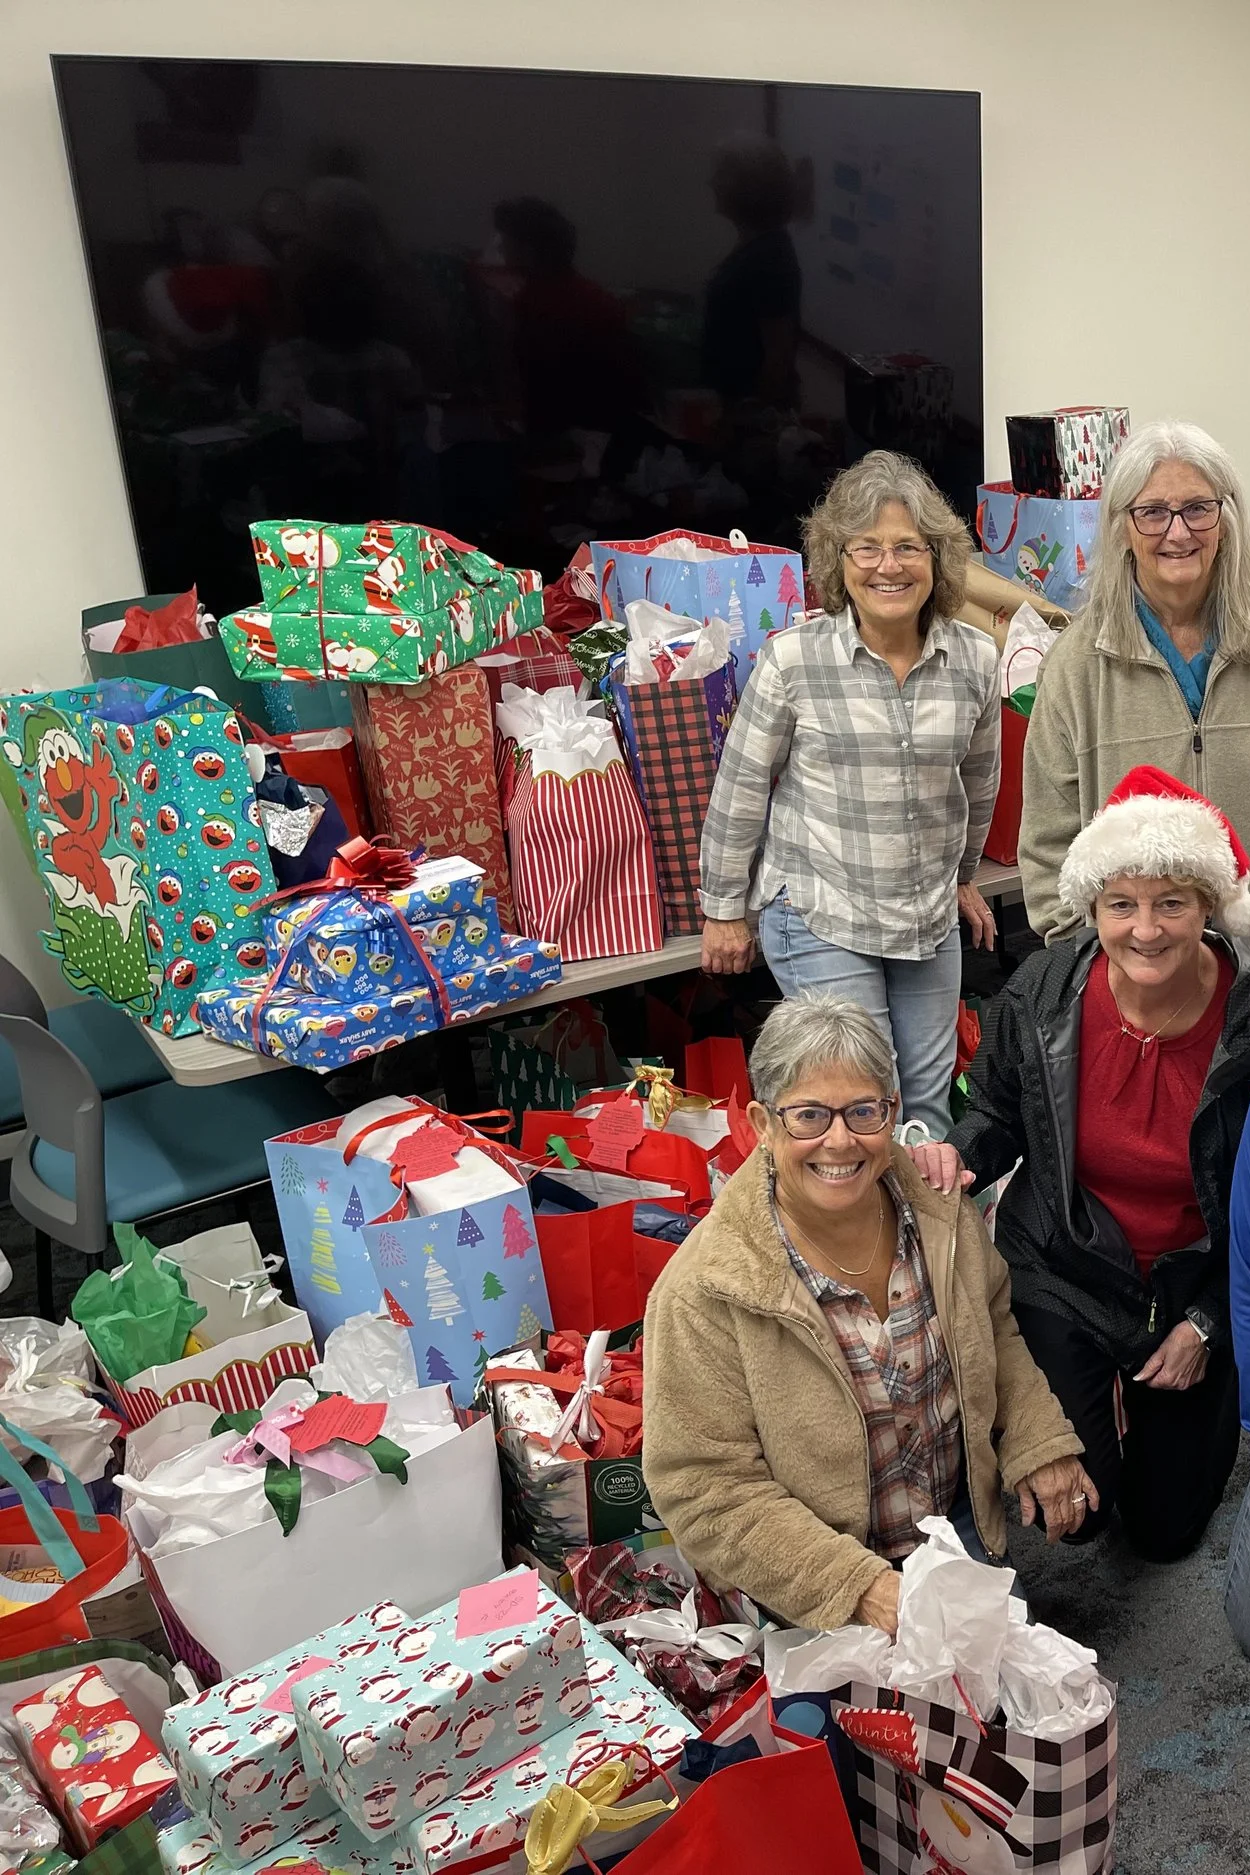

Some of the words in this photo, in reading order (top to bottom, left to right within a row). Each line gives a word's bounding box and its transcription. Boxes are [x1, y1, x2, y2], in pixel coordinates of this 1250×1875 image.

[528, 967, 546, 980] SHARK
[544, 964, 560, 976] BABY
[339, 1031, 361, 1045] SHARK
[359, 1028, 377, 1039] BABY
[611, 1476, 634, 1484] 100%
[847, 1717, 908, 1741] Winter
